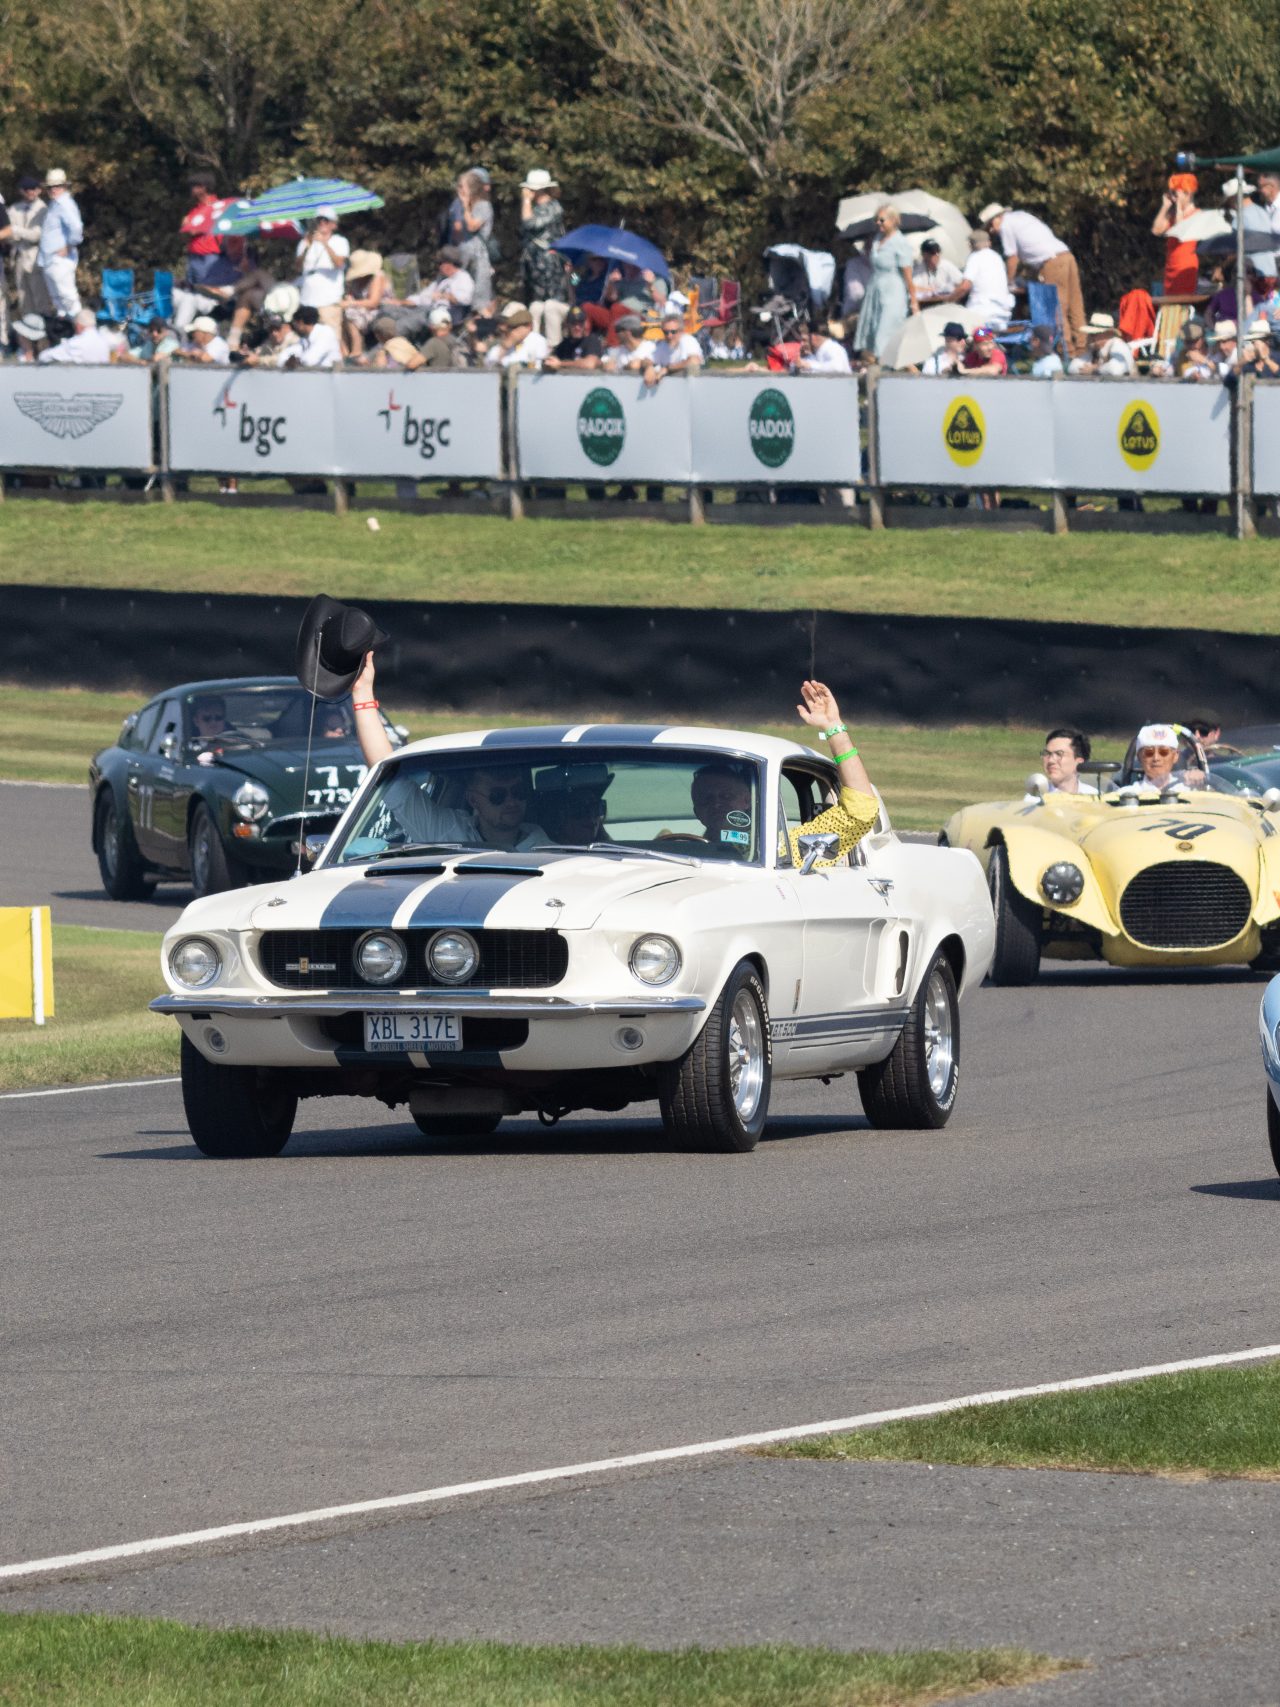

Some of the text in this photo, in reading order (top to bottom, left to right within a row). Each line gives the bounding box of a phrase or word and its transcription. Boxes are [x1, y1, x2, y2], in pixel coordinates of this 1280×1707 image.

[239, 403, 287, 457] bgc
[403, 405, 451, 459] bgc
[578, 417, 624, 437] RADOX
[750, 418, 793, 439] RADOX
[949, 430, 980, 444] LOTUS
[1123, 436, 1155, 449] LOTUS
[1137, 818, 1217, 840] 70
[370, 1016, 456, 1040] XBL 317E
